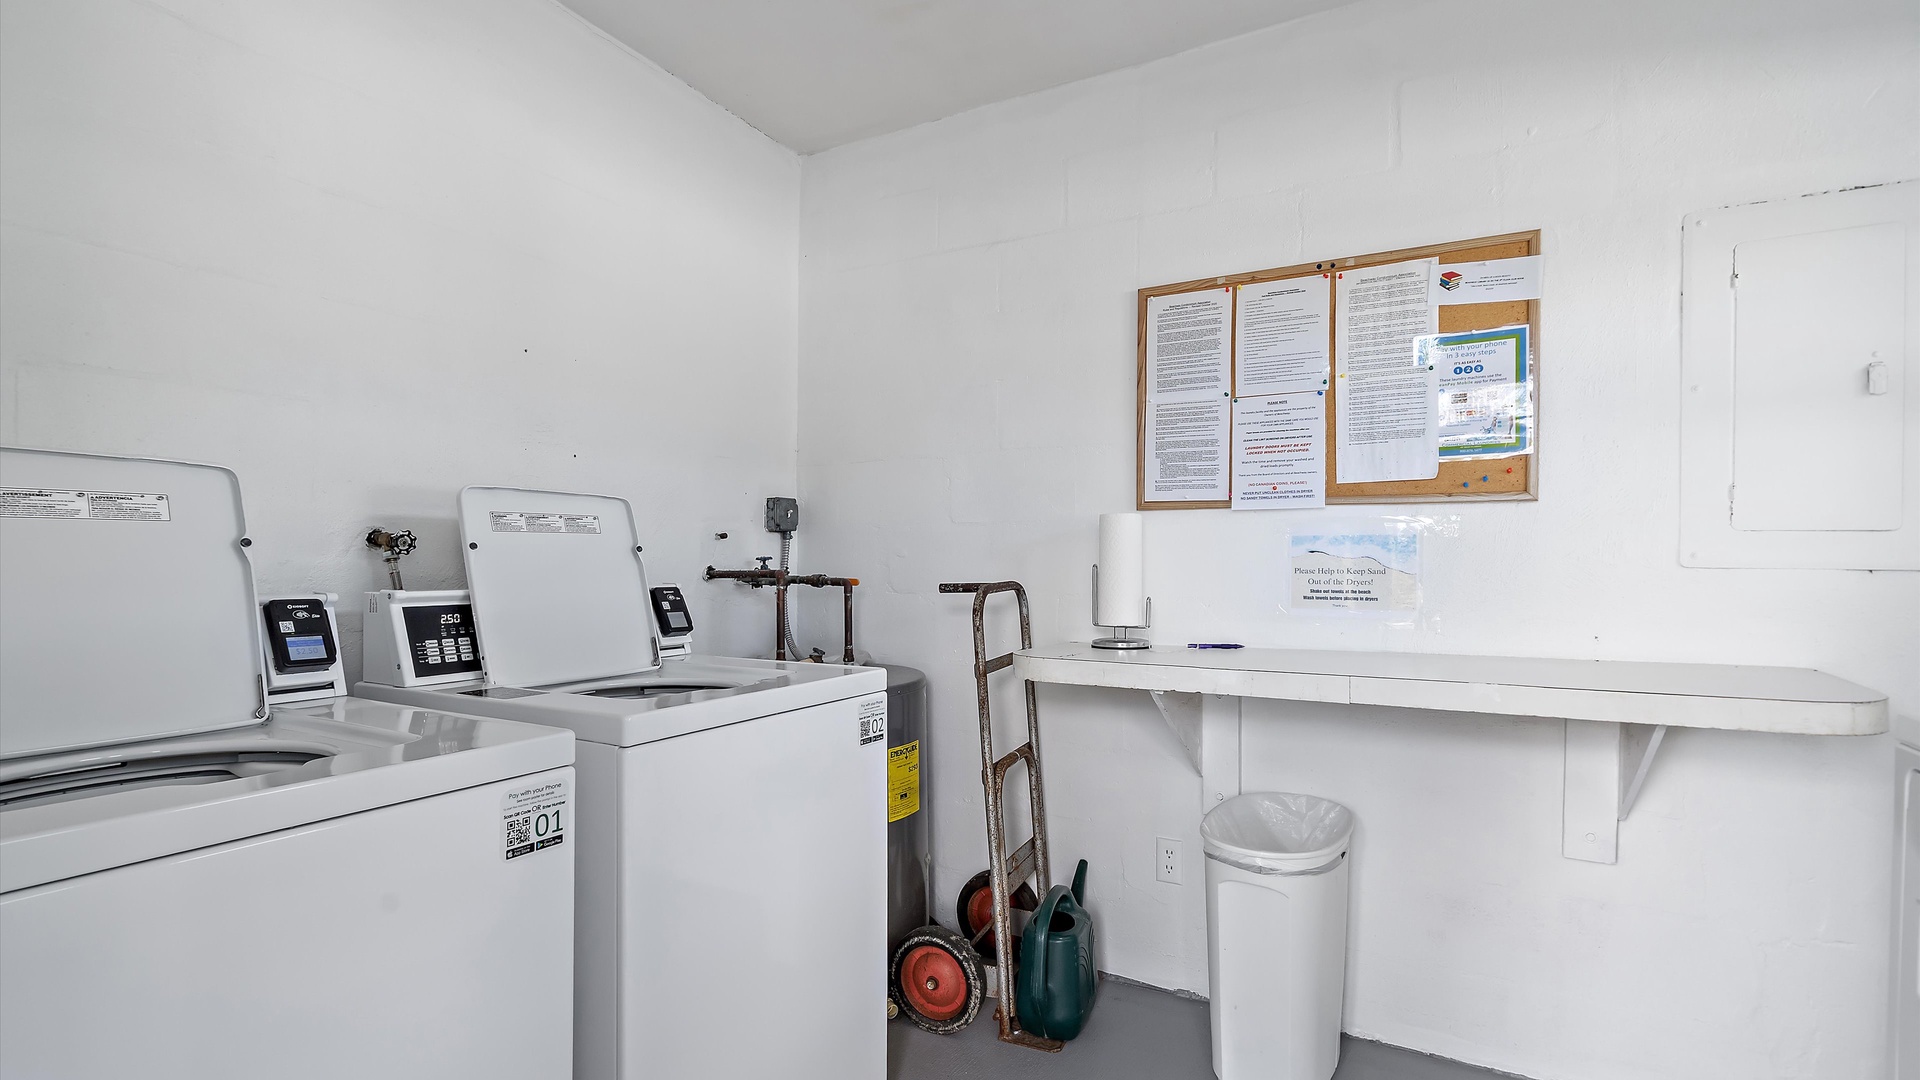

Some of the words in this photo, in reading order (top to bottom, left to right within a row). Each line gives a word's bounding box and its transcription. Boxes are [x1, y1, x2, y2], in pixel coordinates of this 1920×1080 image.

[1484, 340, 1507, 349] phone
[1346, 568, 1366, 576] Keep
[441, 614, 460, 624] 2.50
[872, 718, 884, 733] 02
[535, 810, 563, 837] 01
